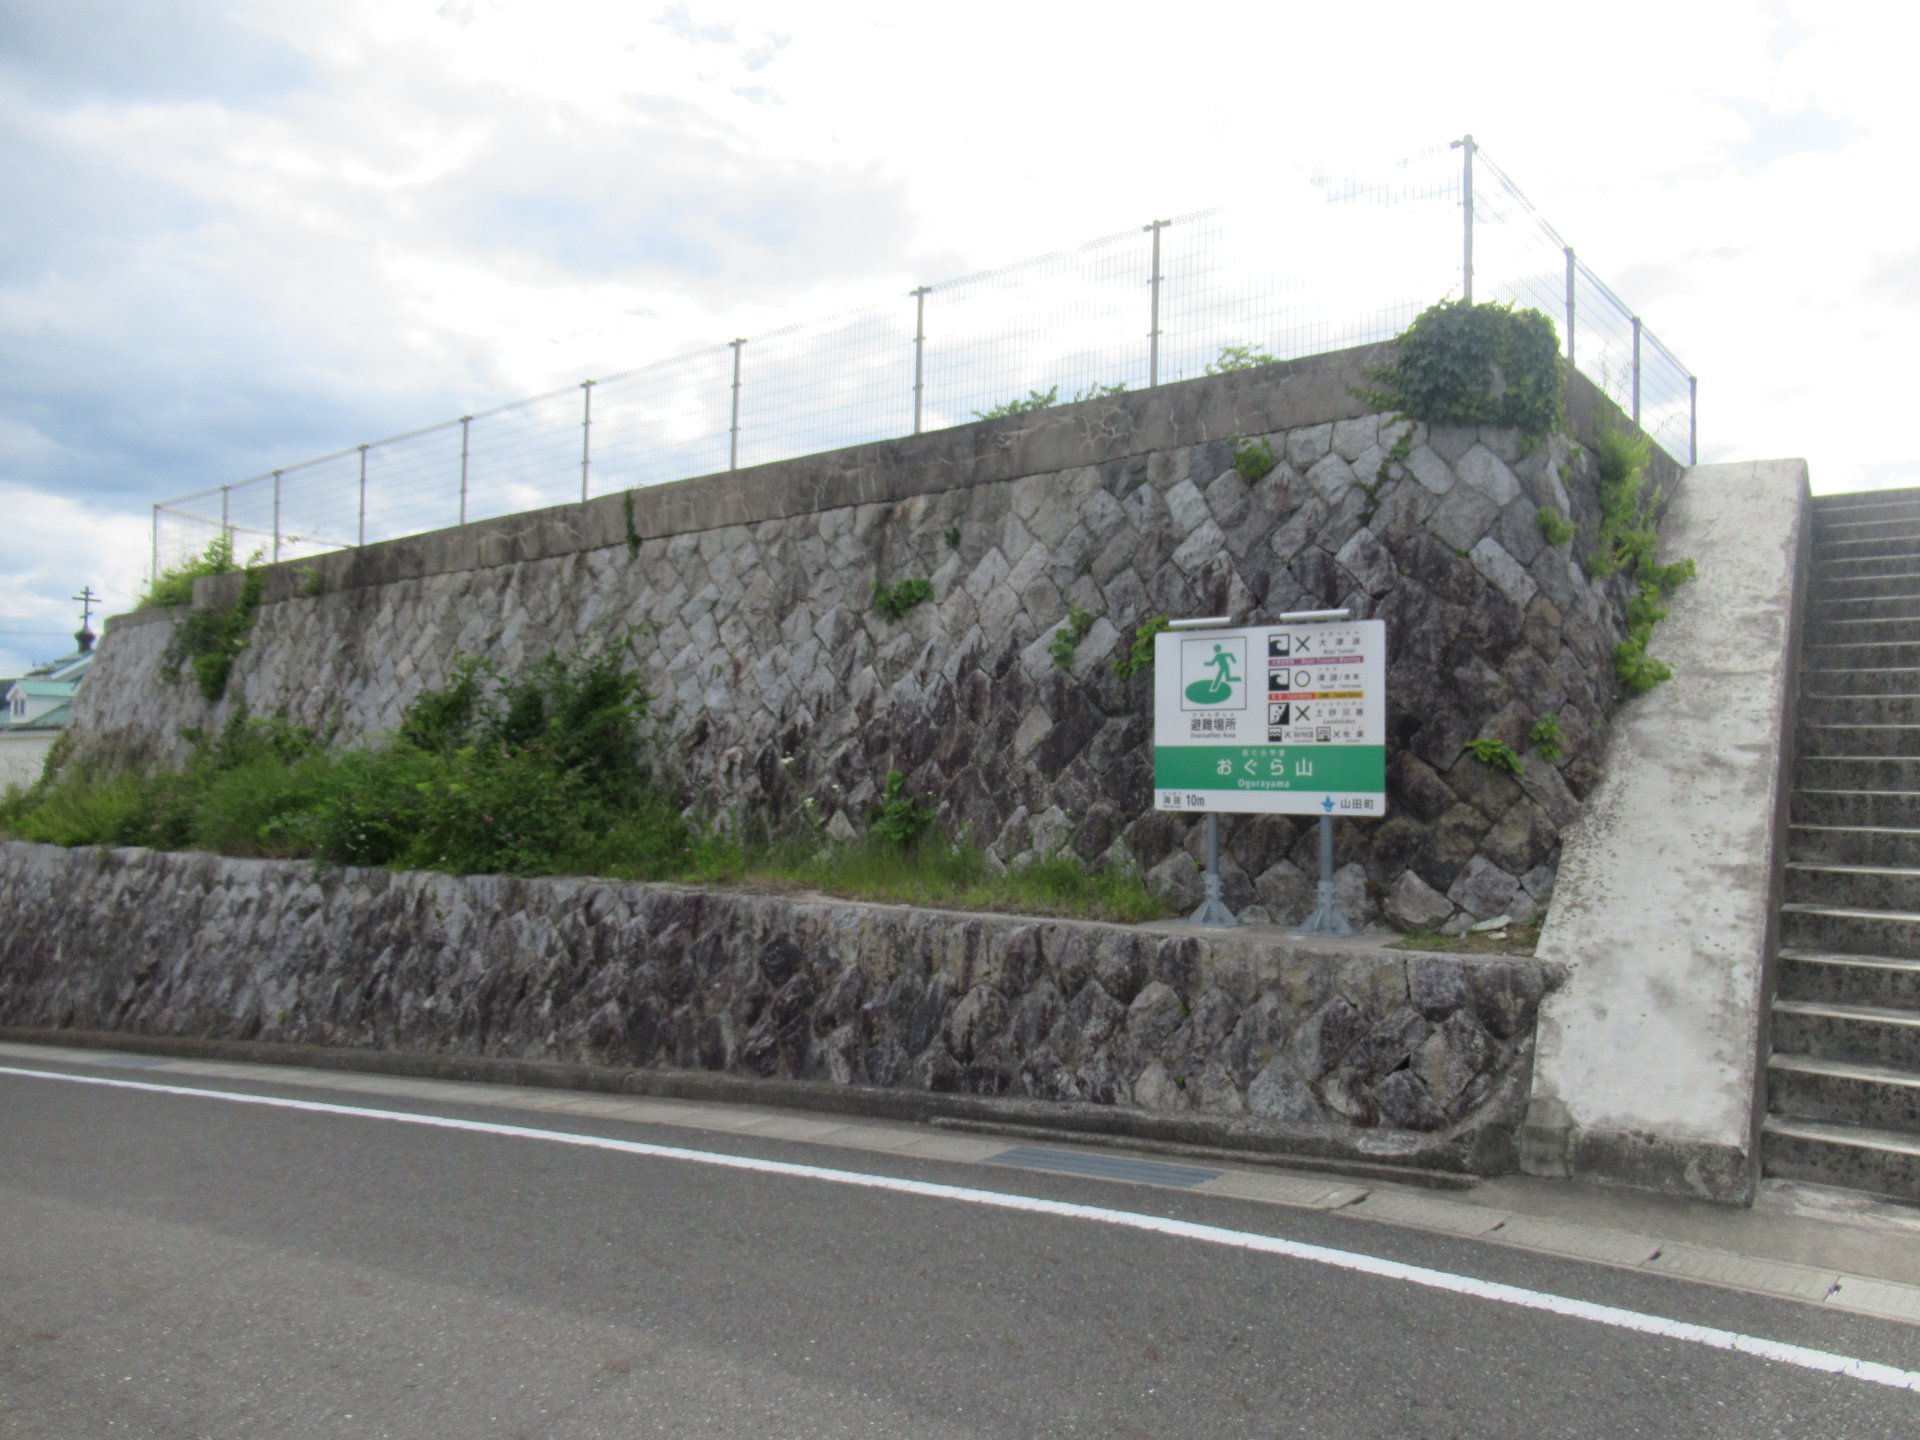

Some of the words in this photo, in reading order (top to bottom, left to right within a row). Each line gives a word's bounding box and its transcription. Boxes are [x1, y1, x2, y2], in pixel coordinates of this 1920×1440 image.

[1190, 718, 1237, 731] 避難場所
[1241, 749, 1286, 757] おぐらやま
[1216, 758, 1313, 777] おぐら山
[1238, 779, 1290, 788] Ogurayama
[1186, 794, 1205, 806] 10m
[1340, 798, 1374, 809] 山田町
